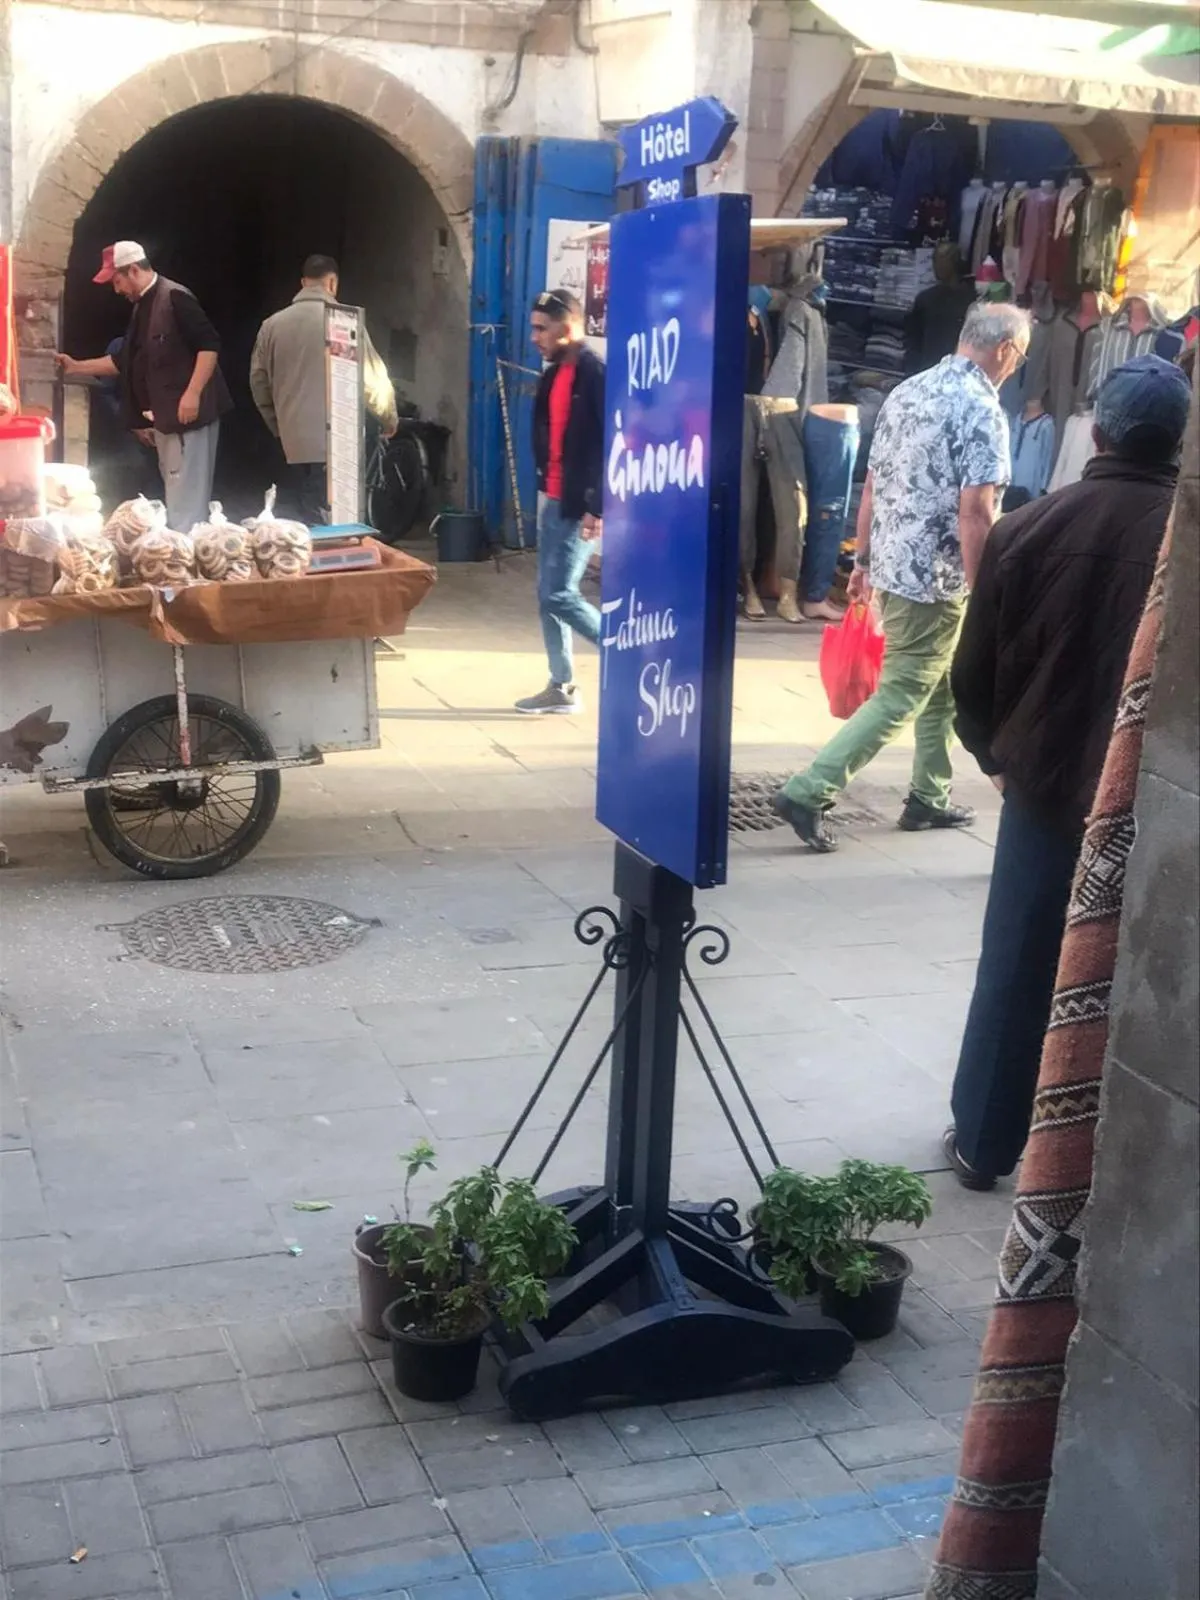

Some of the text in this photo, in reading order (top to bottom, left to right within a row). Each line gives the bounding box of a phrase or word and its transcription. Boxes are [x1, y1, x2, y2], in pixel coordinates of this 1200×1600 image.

[641, 110, 690, 166] Hôtel
[648, 177, 680, 200] Shop
[627, 317, 680, 396] RIAD
[601, 587, 678, 690] Fatima
[637, 658, 696, 738] Shop
